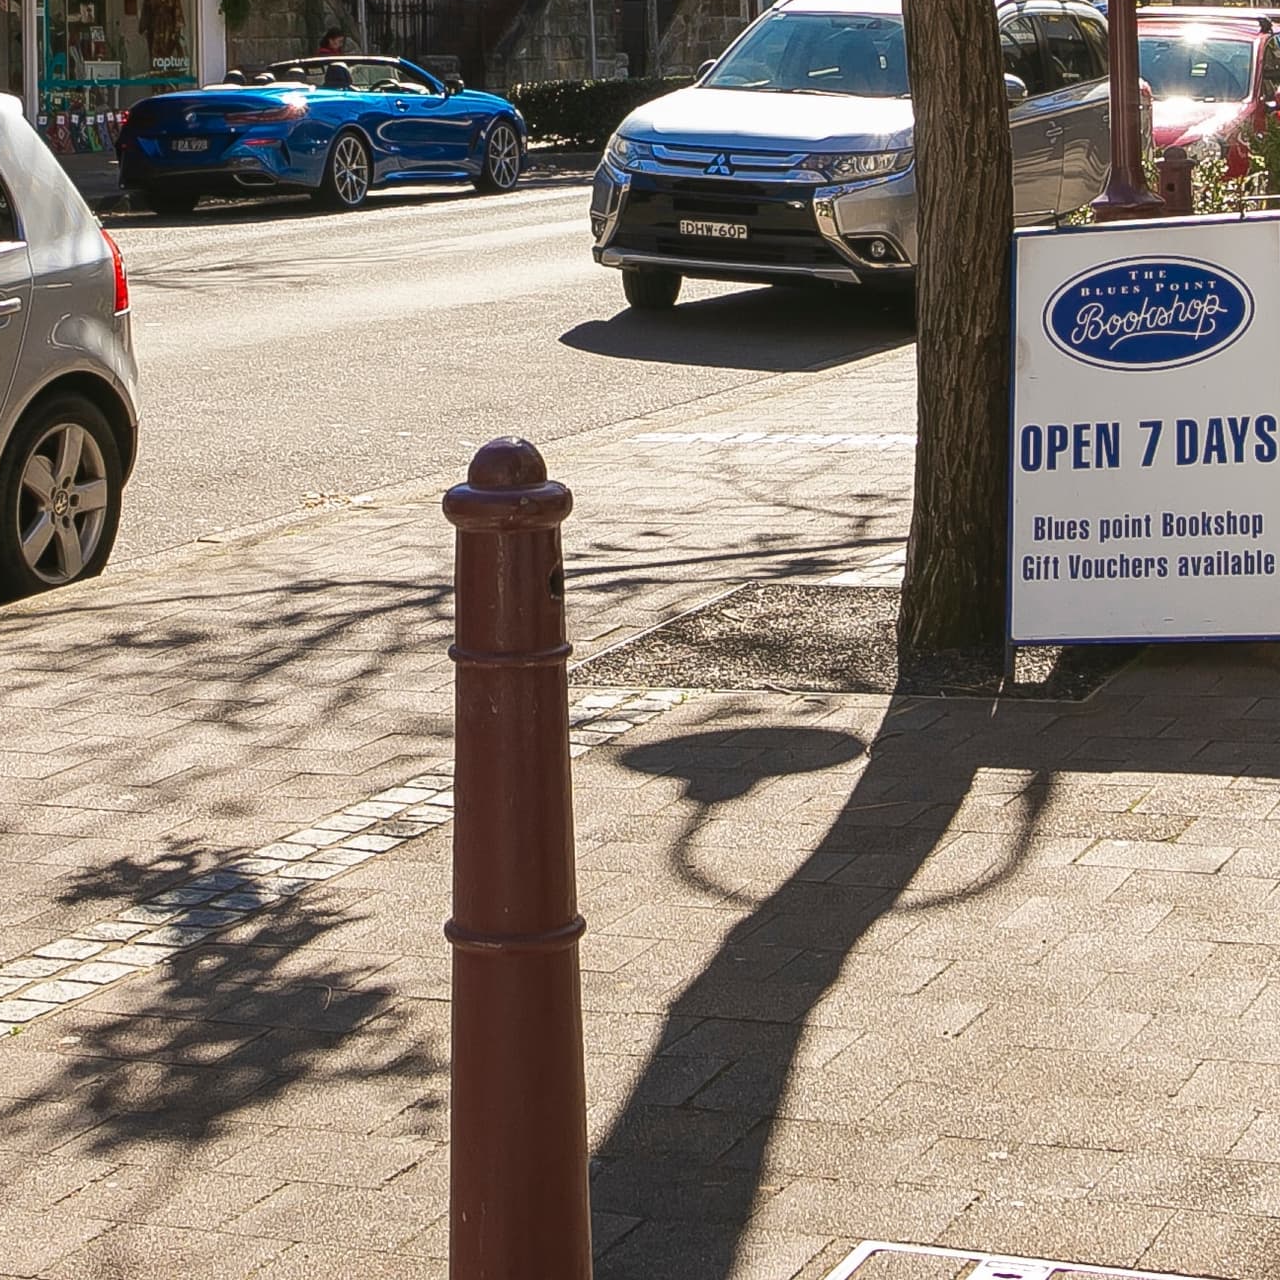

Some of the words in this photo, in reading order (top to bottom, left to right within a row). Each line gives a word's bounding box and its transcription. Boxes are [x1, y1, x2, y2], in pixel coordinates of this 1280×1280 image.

[1128, 270, 1167, 280] THE
[1071, 294, 1228, 345] Bookshop
[1020, 422, 1120, 471] OPEN
[1139, 420, 1163, 467] 7
[1176, 414, 1277, 466] DAYS
[1033, 516, 1090, 541] Blues
[1099, 514, 1151, 543] point
[1161, 510, 1264, 539] Bookshop
[1022, 555, 1059, 581] Gift
[1068, 553, 1168, 579] Vouchers
[1178, 549, 1275, 577] available
